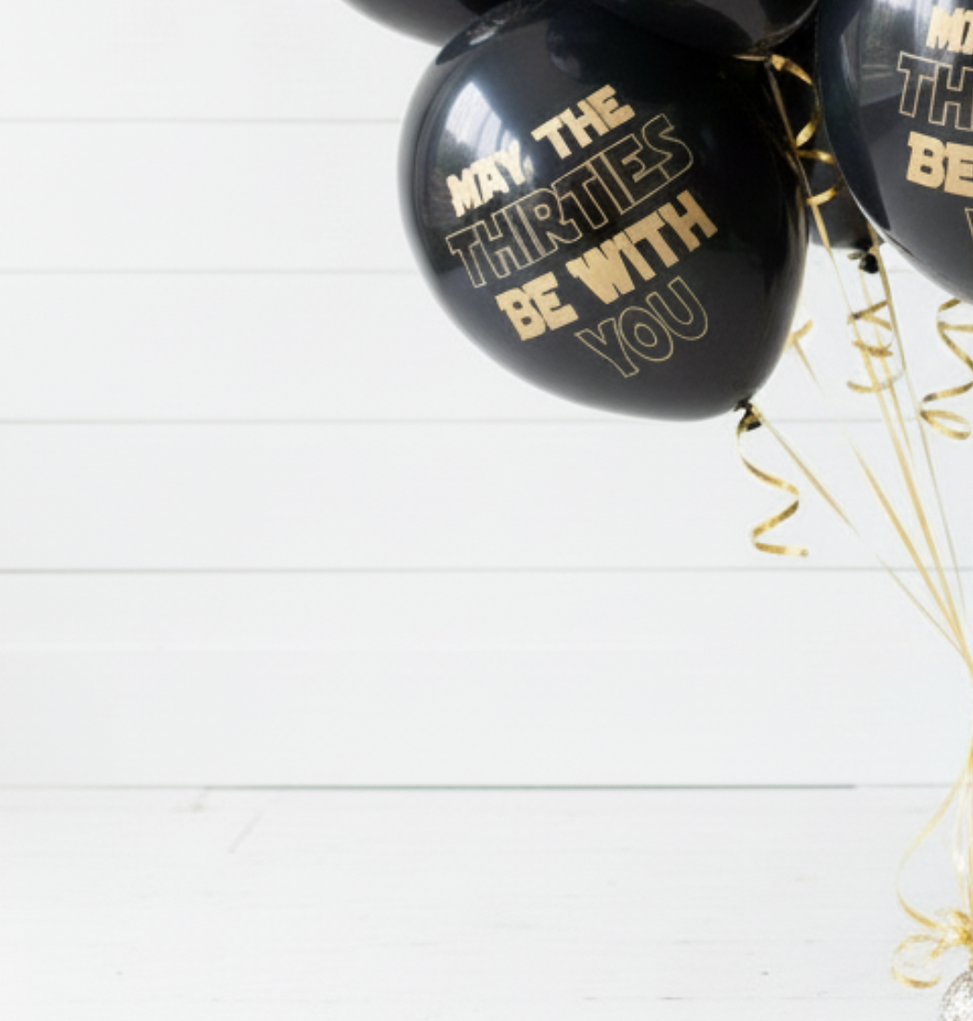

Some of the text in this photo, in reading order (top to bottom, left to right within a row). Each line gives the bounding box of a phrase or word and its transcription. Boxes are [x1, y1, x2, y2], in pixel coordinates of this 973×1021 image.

[446, 84, 636, 217] MAY THE
[446, 113, 693, 288] THIRTIES
[495, 189, 718, 341] BE WITH
[574, 276, 708, 378] YOU
